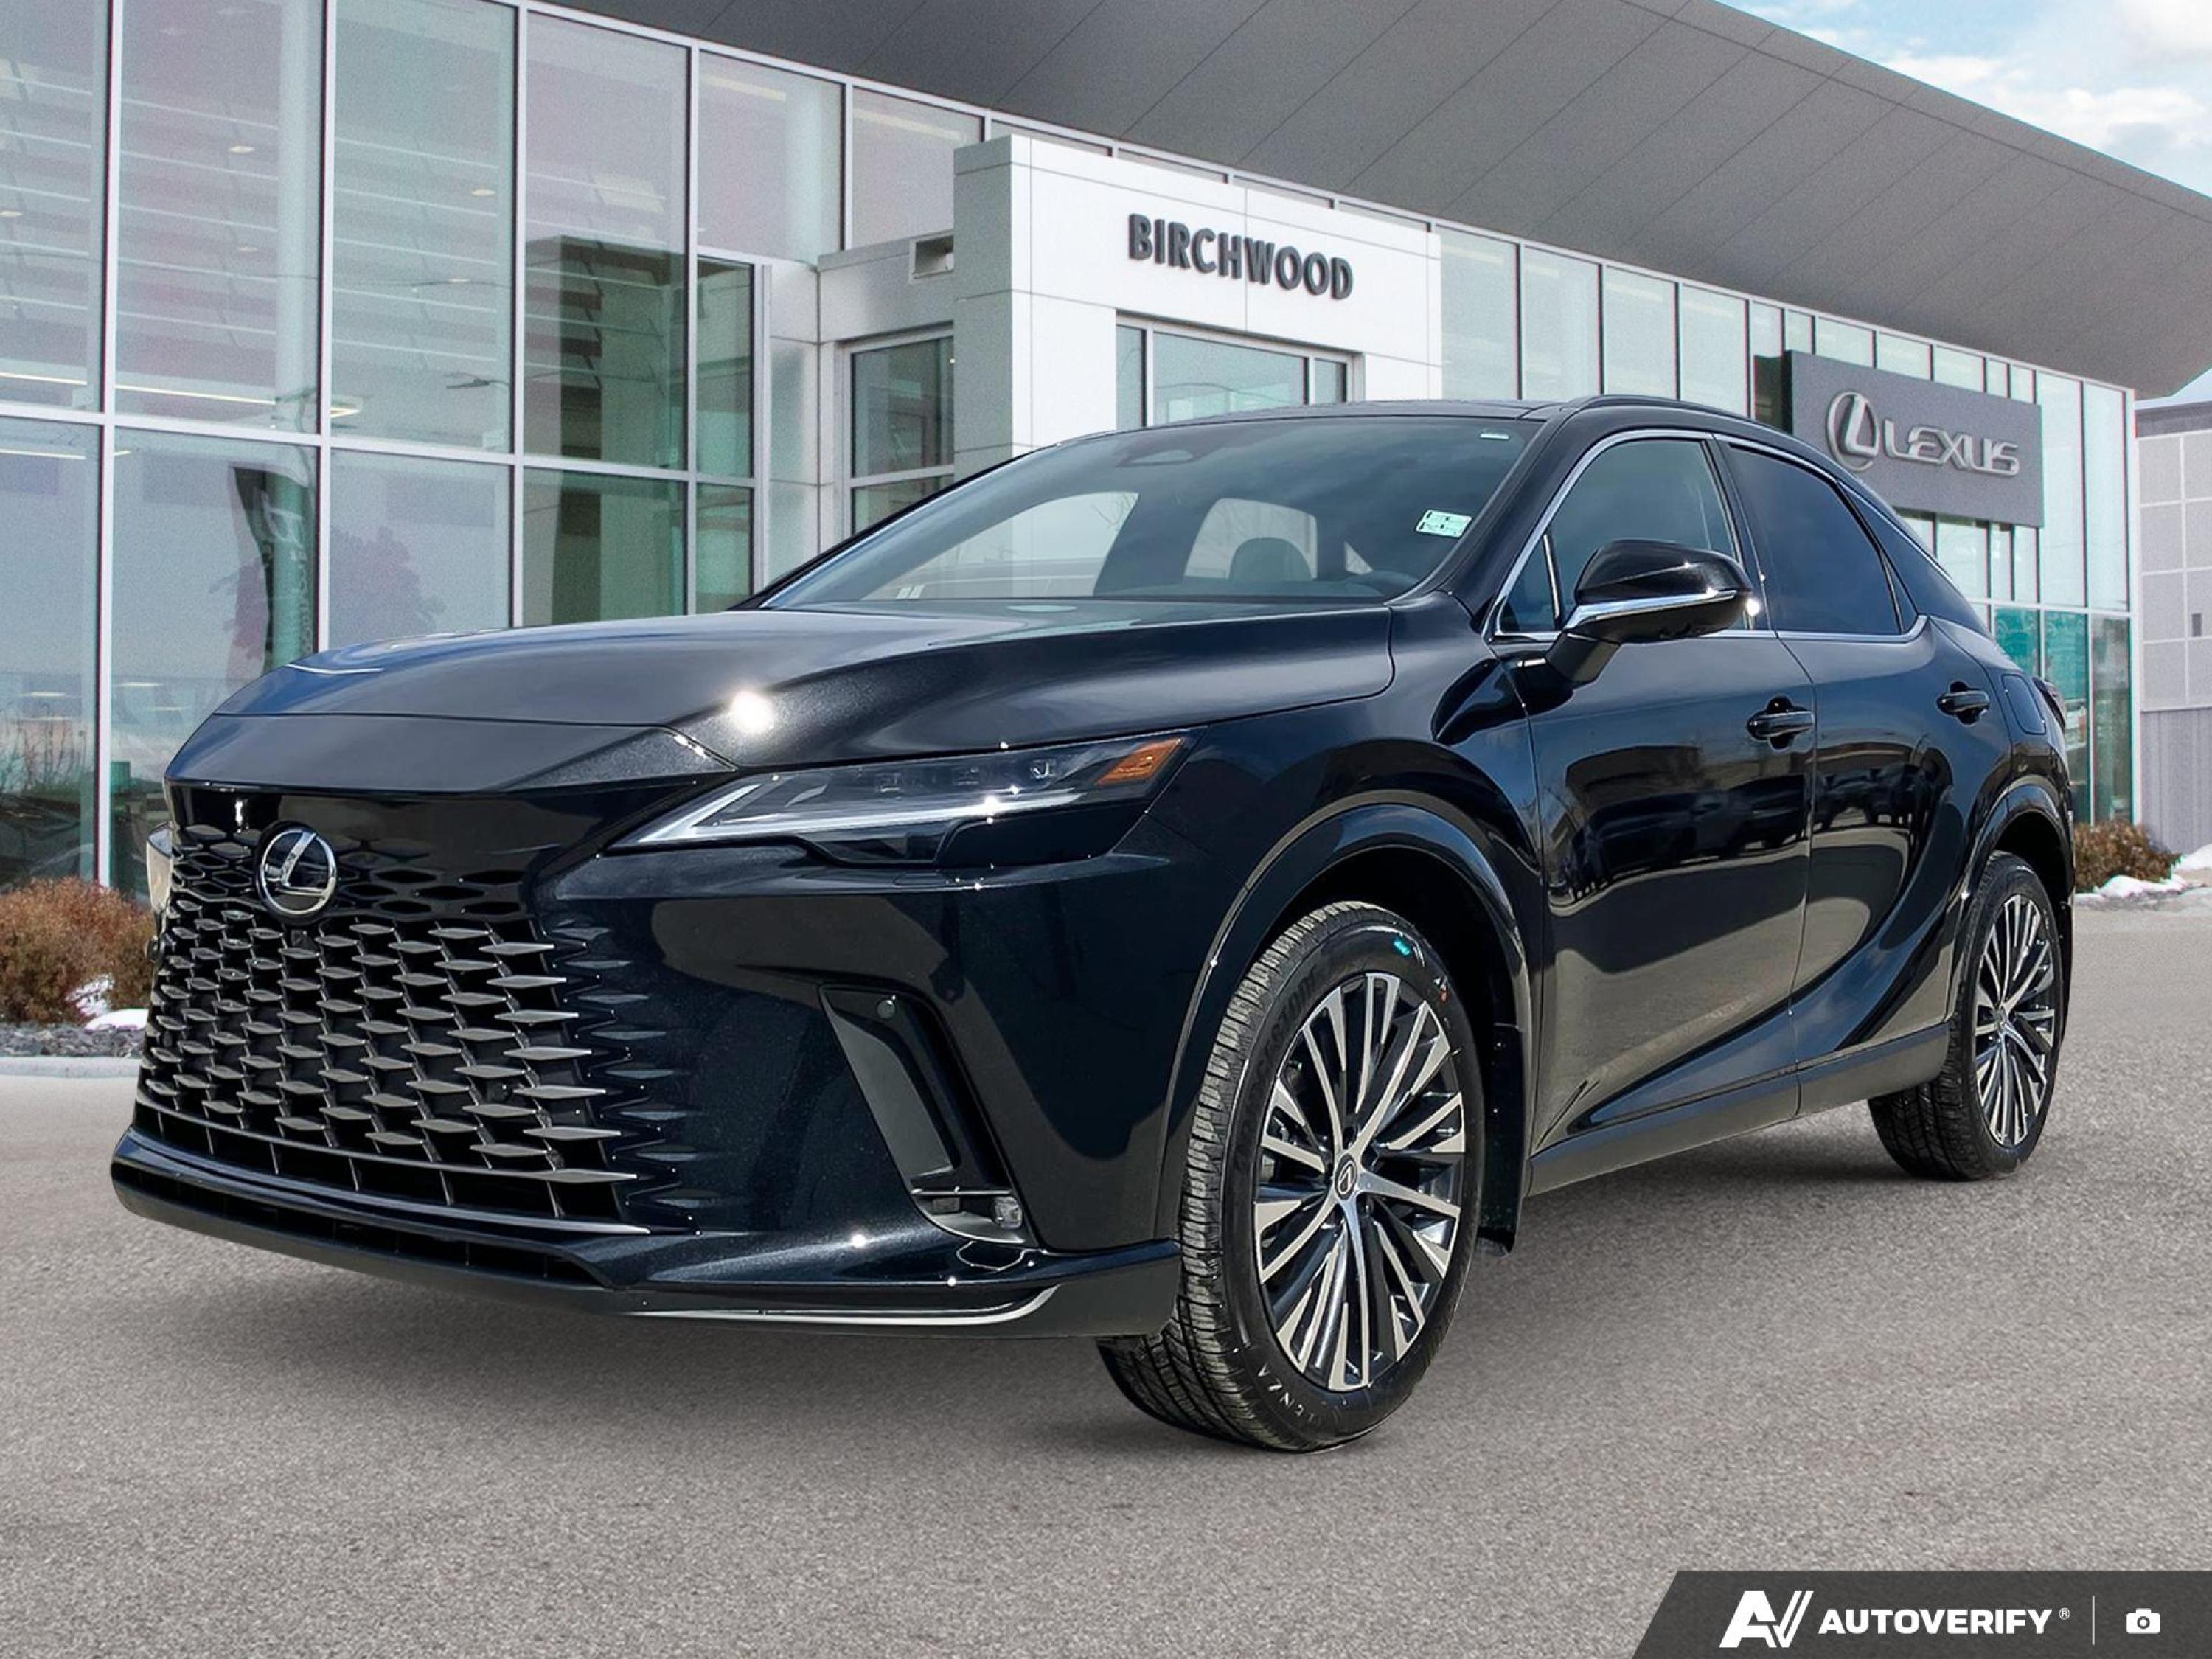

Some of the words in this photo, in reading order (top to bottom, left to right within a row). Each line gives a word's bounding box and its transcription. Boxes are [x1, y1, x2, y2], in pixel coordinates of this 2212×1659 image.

[1128, 213, 1354, 300] BIRCHWOOD
[1884, 419, 2020, 476] LEXUS
[1256, 1362, 1324, 1429] LENZA
